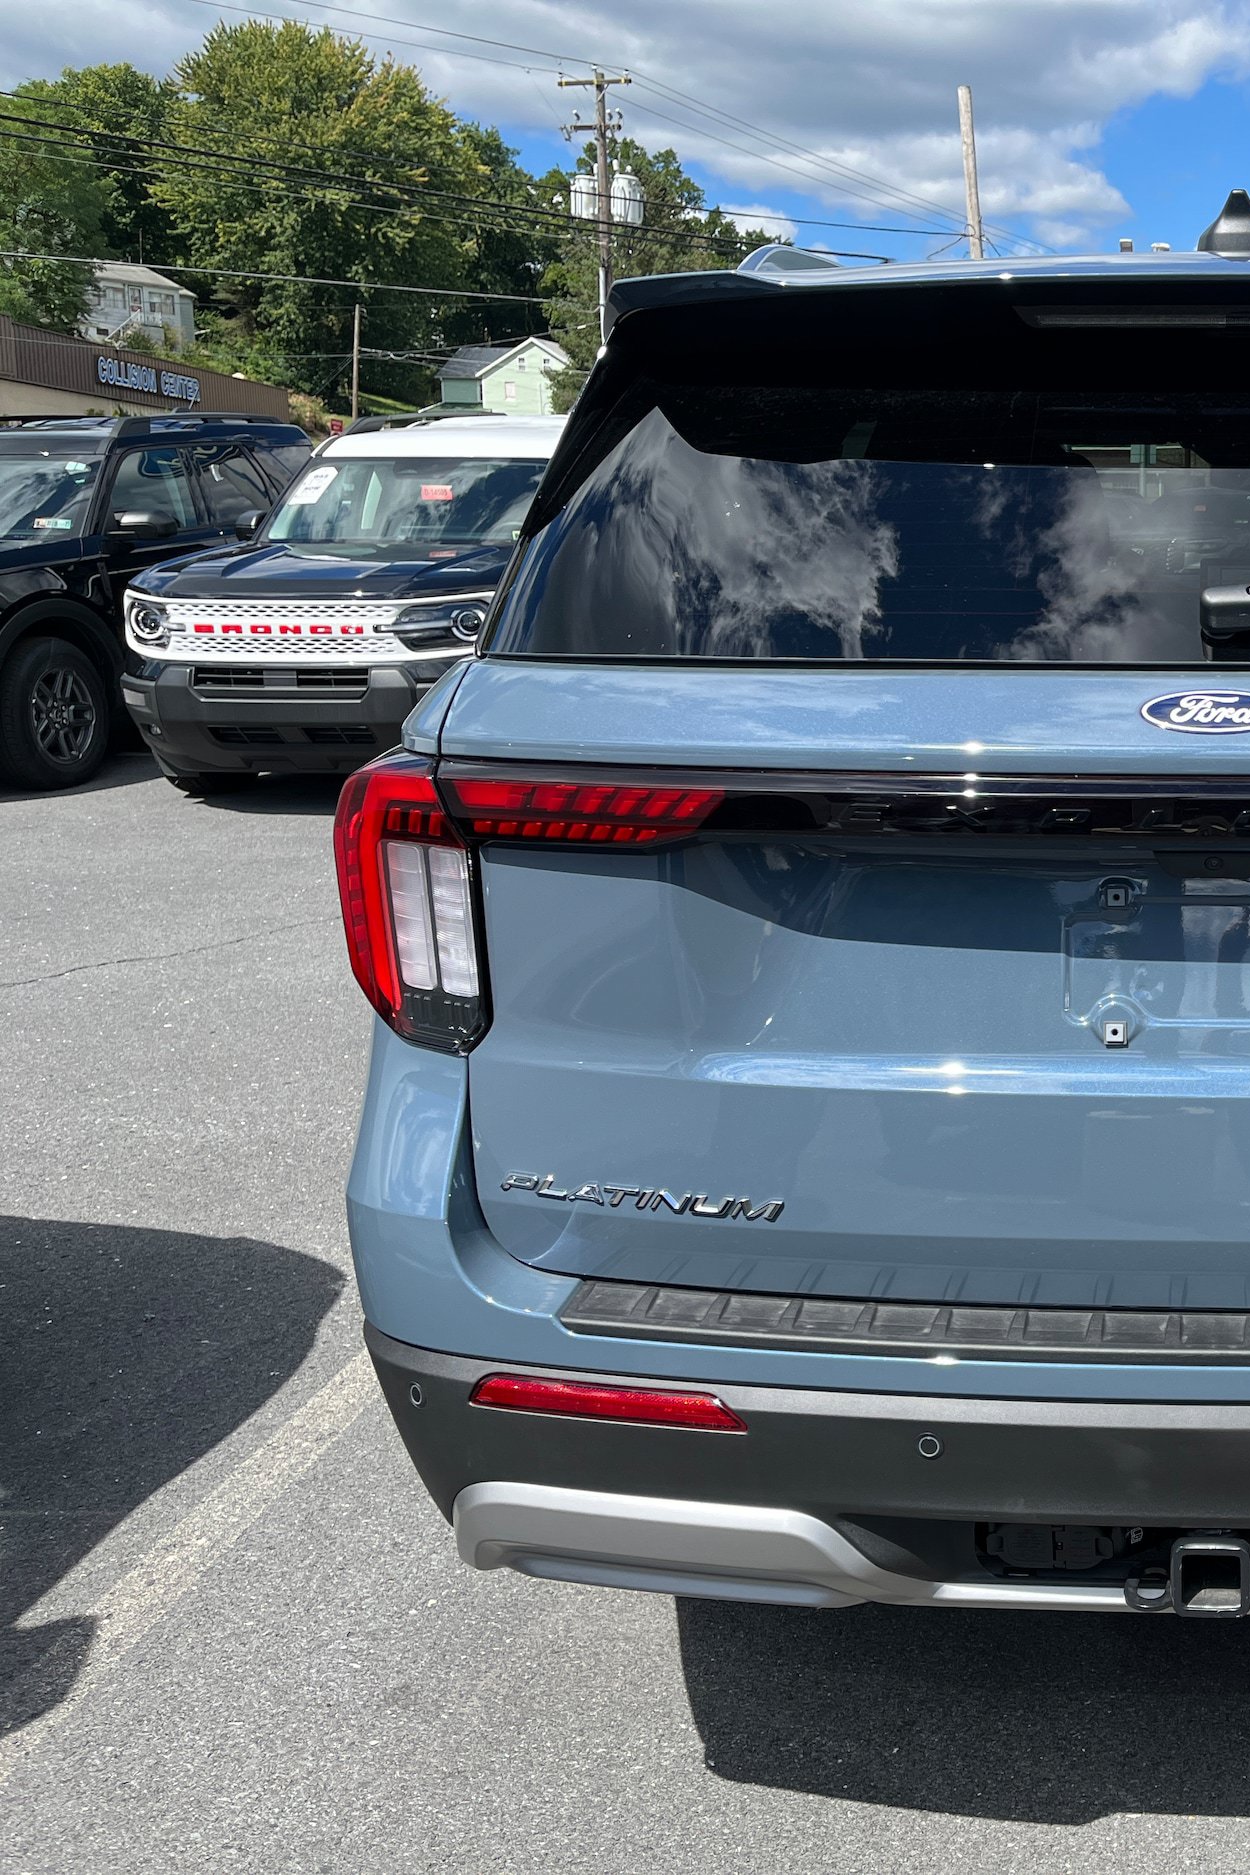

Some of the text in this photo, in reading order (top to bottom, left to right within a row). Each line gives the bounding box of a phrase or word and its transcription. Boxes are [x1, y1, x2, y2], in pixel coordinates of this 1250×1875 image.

[98, 356, 200, 402] COLLISION CENTER
[194, 624, 363, 634] BRONCO
[500, 1170, 785, 1223] PLATINUM
